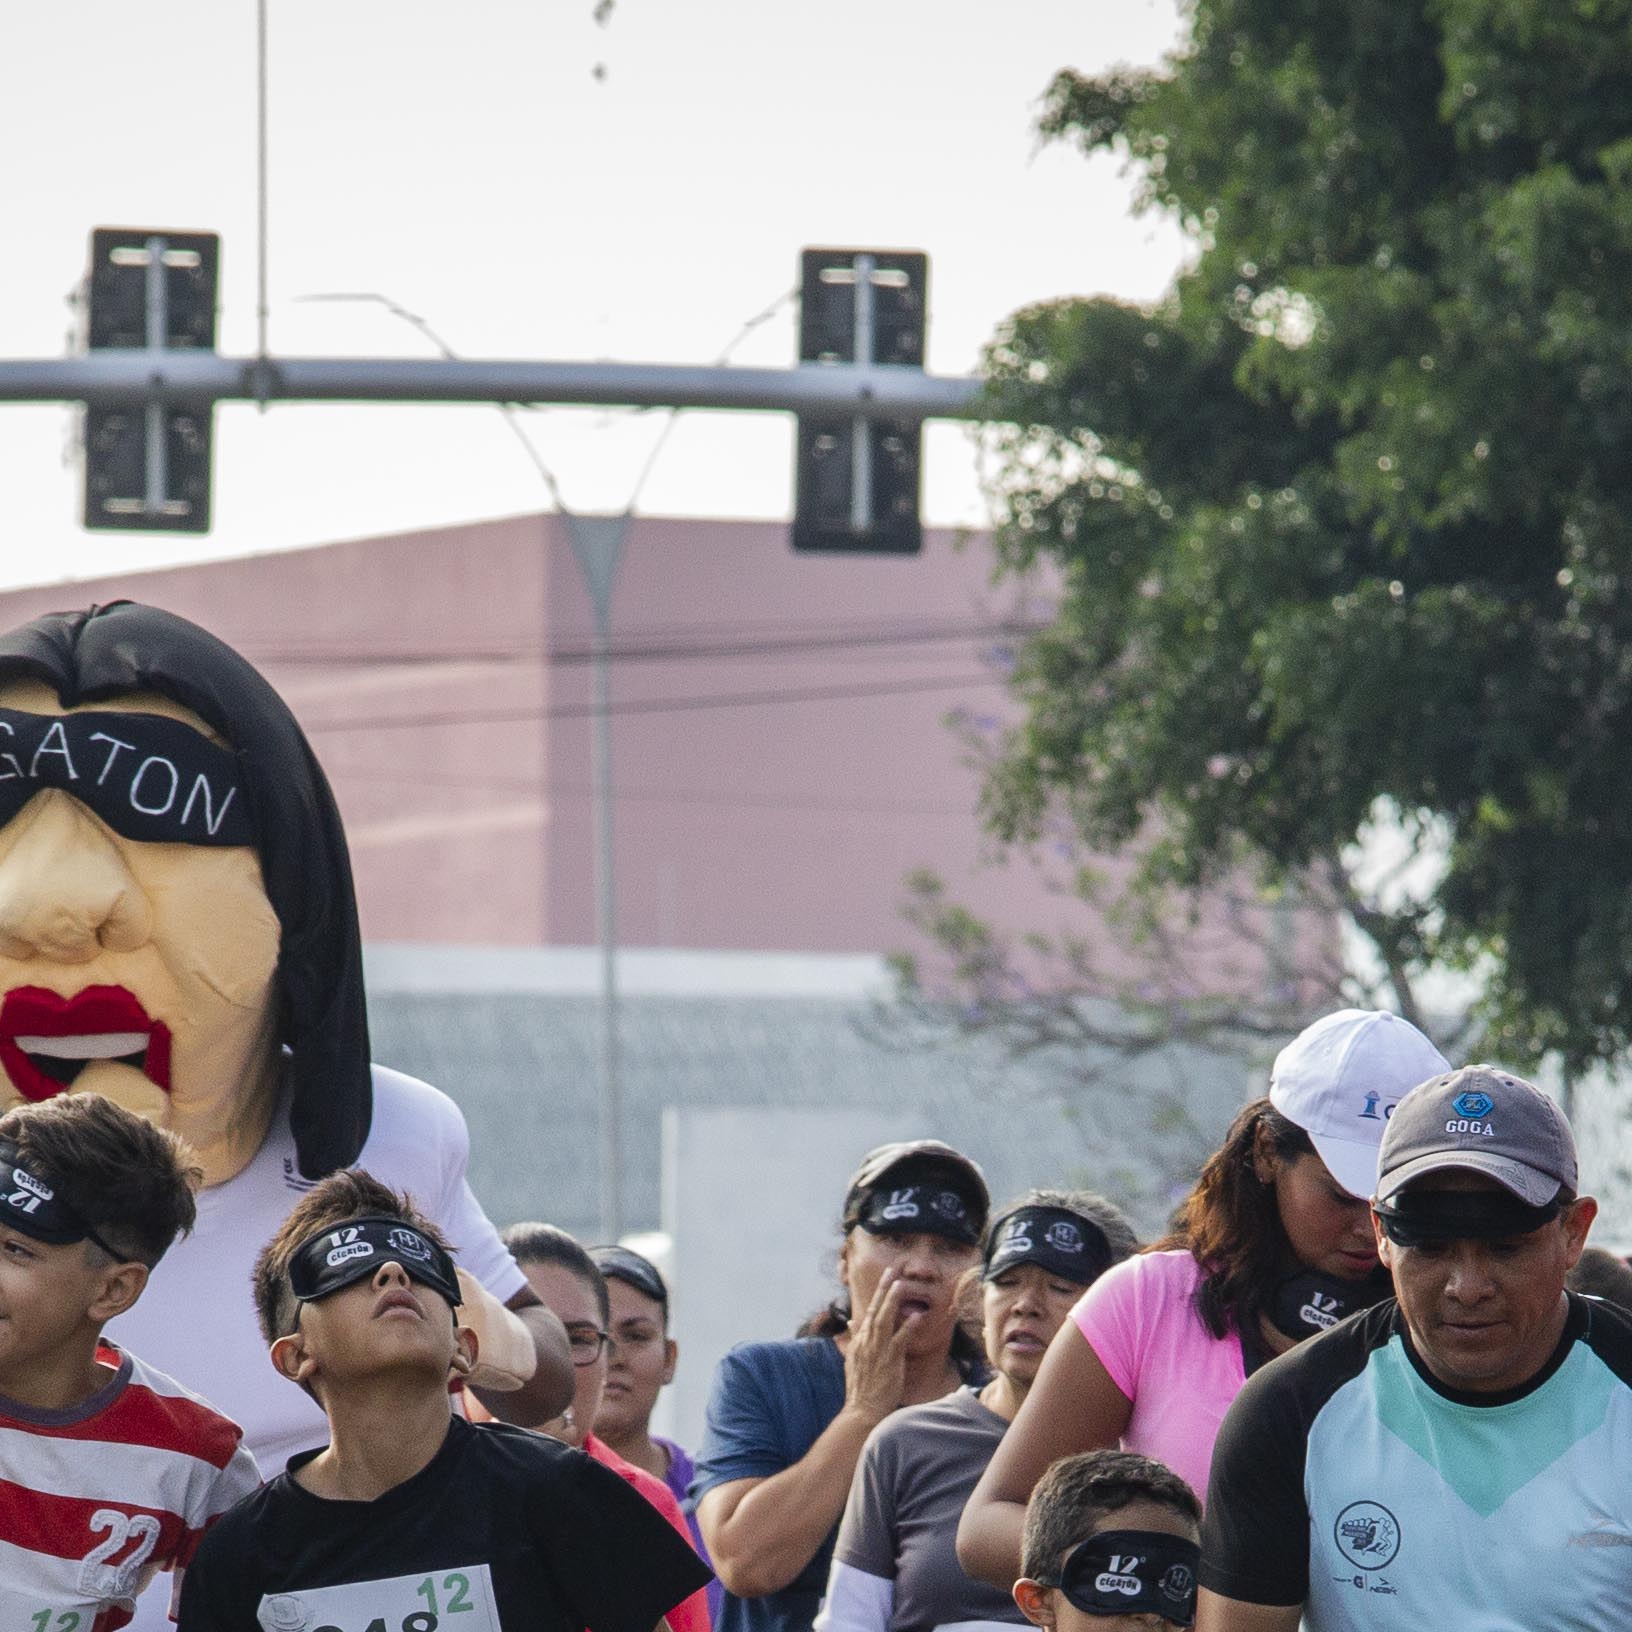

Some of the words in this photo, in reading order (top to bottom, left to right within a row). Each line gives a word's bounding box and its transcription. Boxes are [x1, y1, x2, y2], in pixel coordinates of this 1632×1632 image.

[1445, 1120, 1495, 1136] GOGA
[76, 1509, 161, 1598] 22
[417, 1573, 474, 1616] 12
